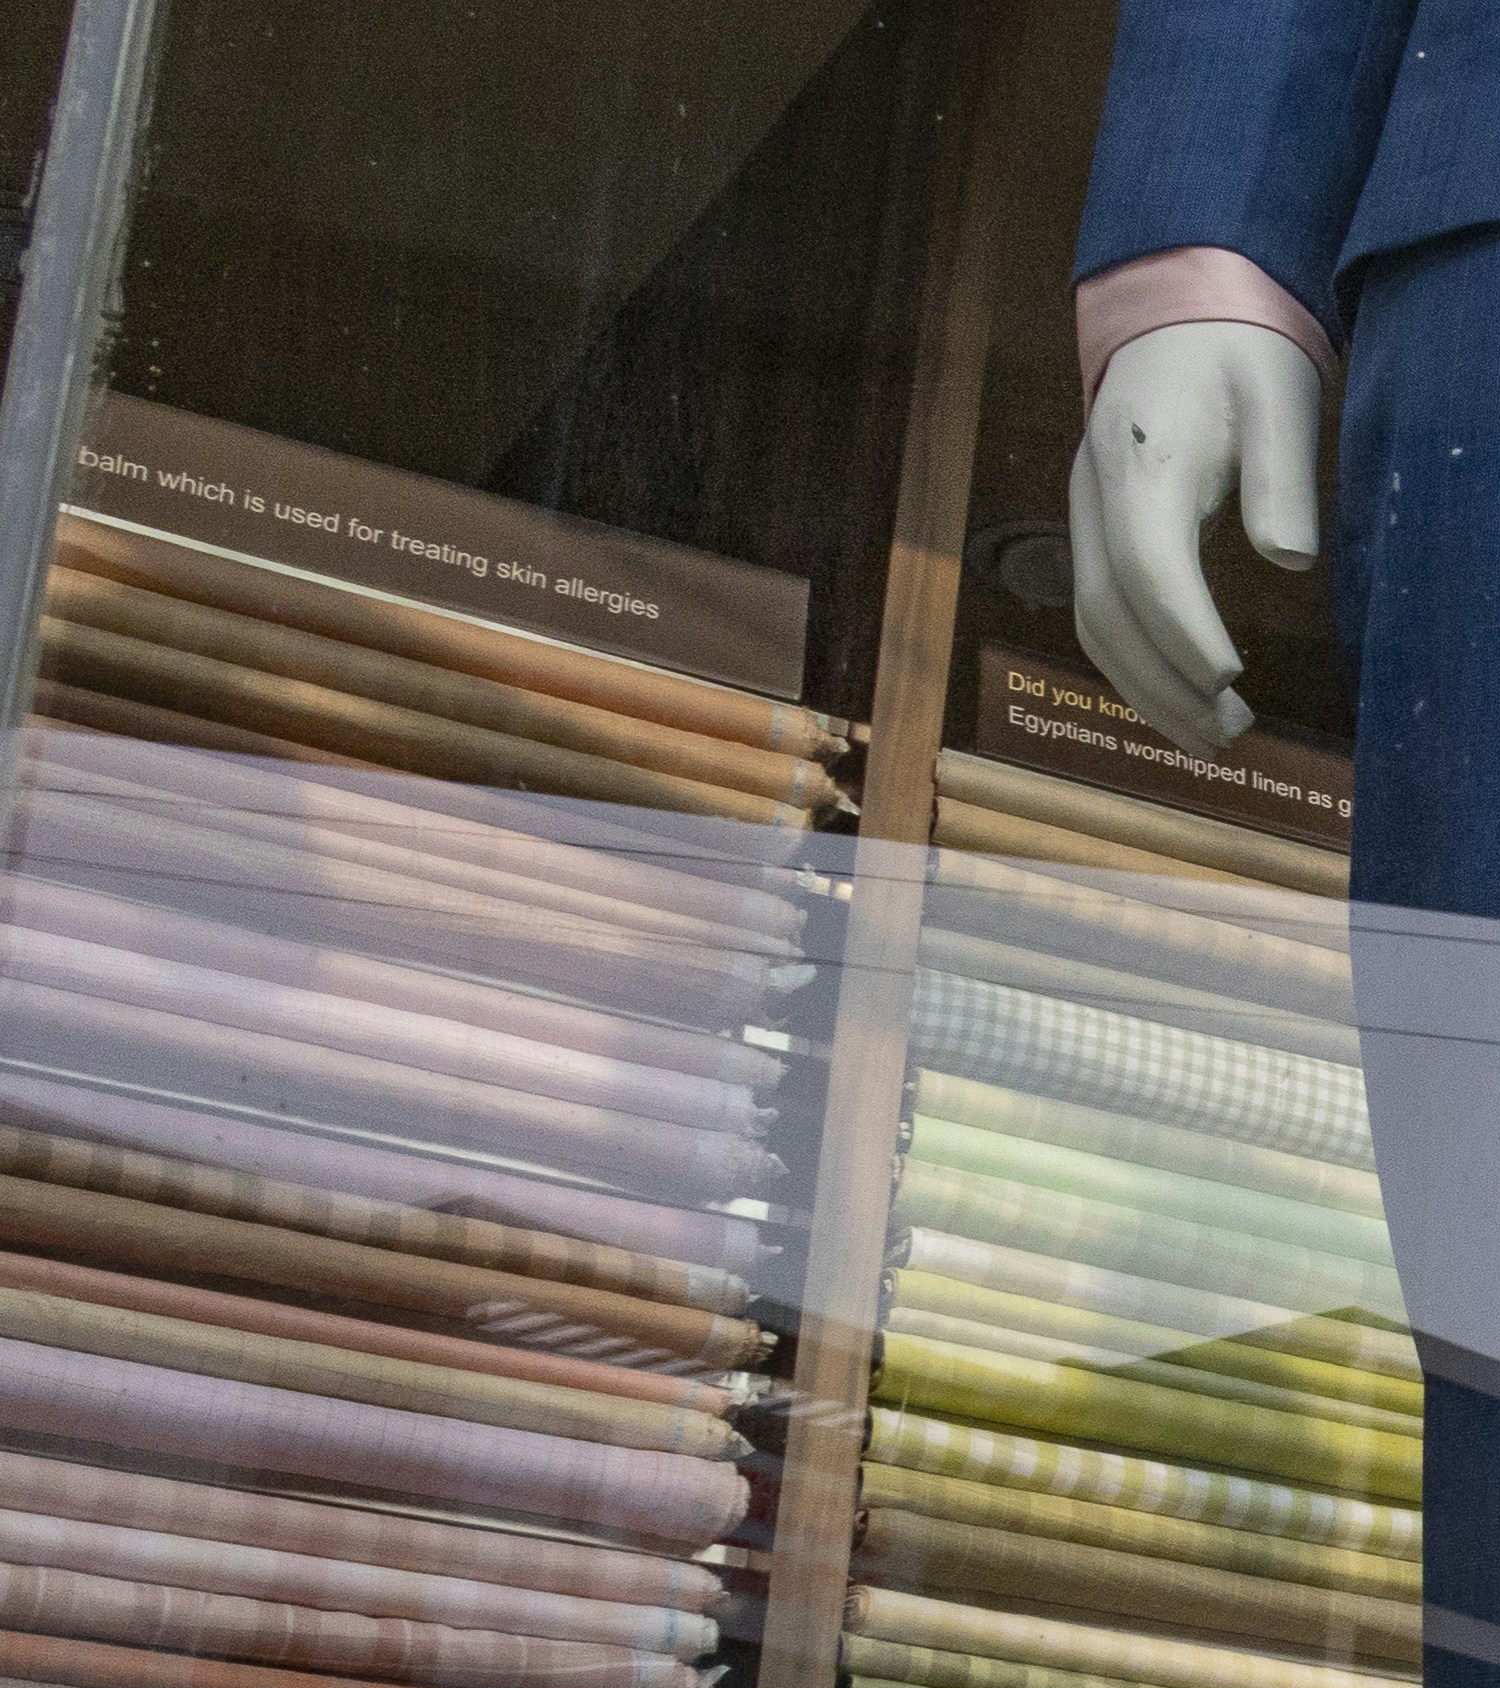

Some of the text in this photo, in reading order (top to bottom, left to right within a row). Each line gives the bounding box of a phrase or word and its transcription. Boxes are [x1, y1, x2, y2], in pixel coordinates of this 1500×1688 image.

[77, 445, 660, 620] balm which is used for treating skin allergies
[1008, 670, 1152, 726] Did you kno
[1008, 704, 1118, 751] Egyptians
[1122, 739, 1247, 786] worshipped
[1252, 770, 1302, 801] linen
[1307, 789, 1333, 809] as
